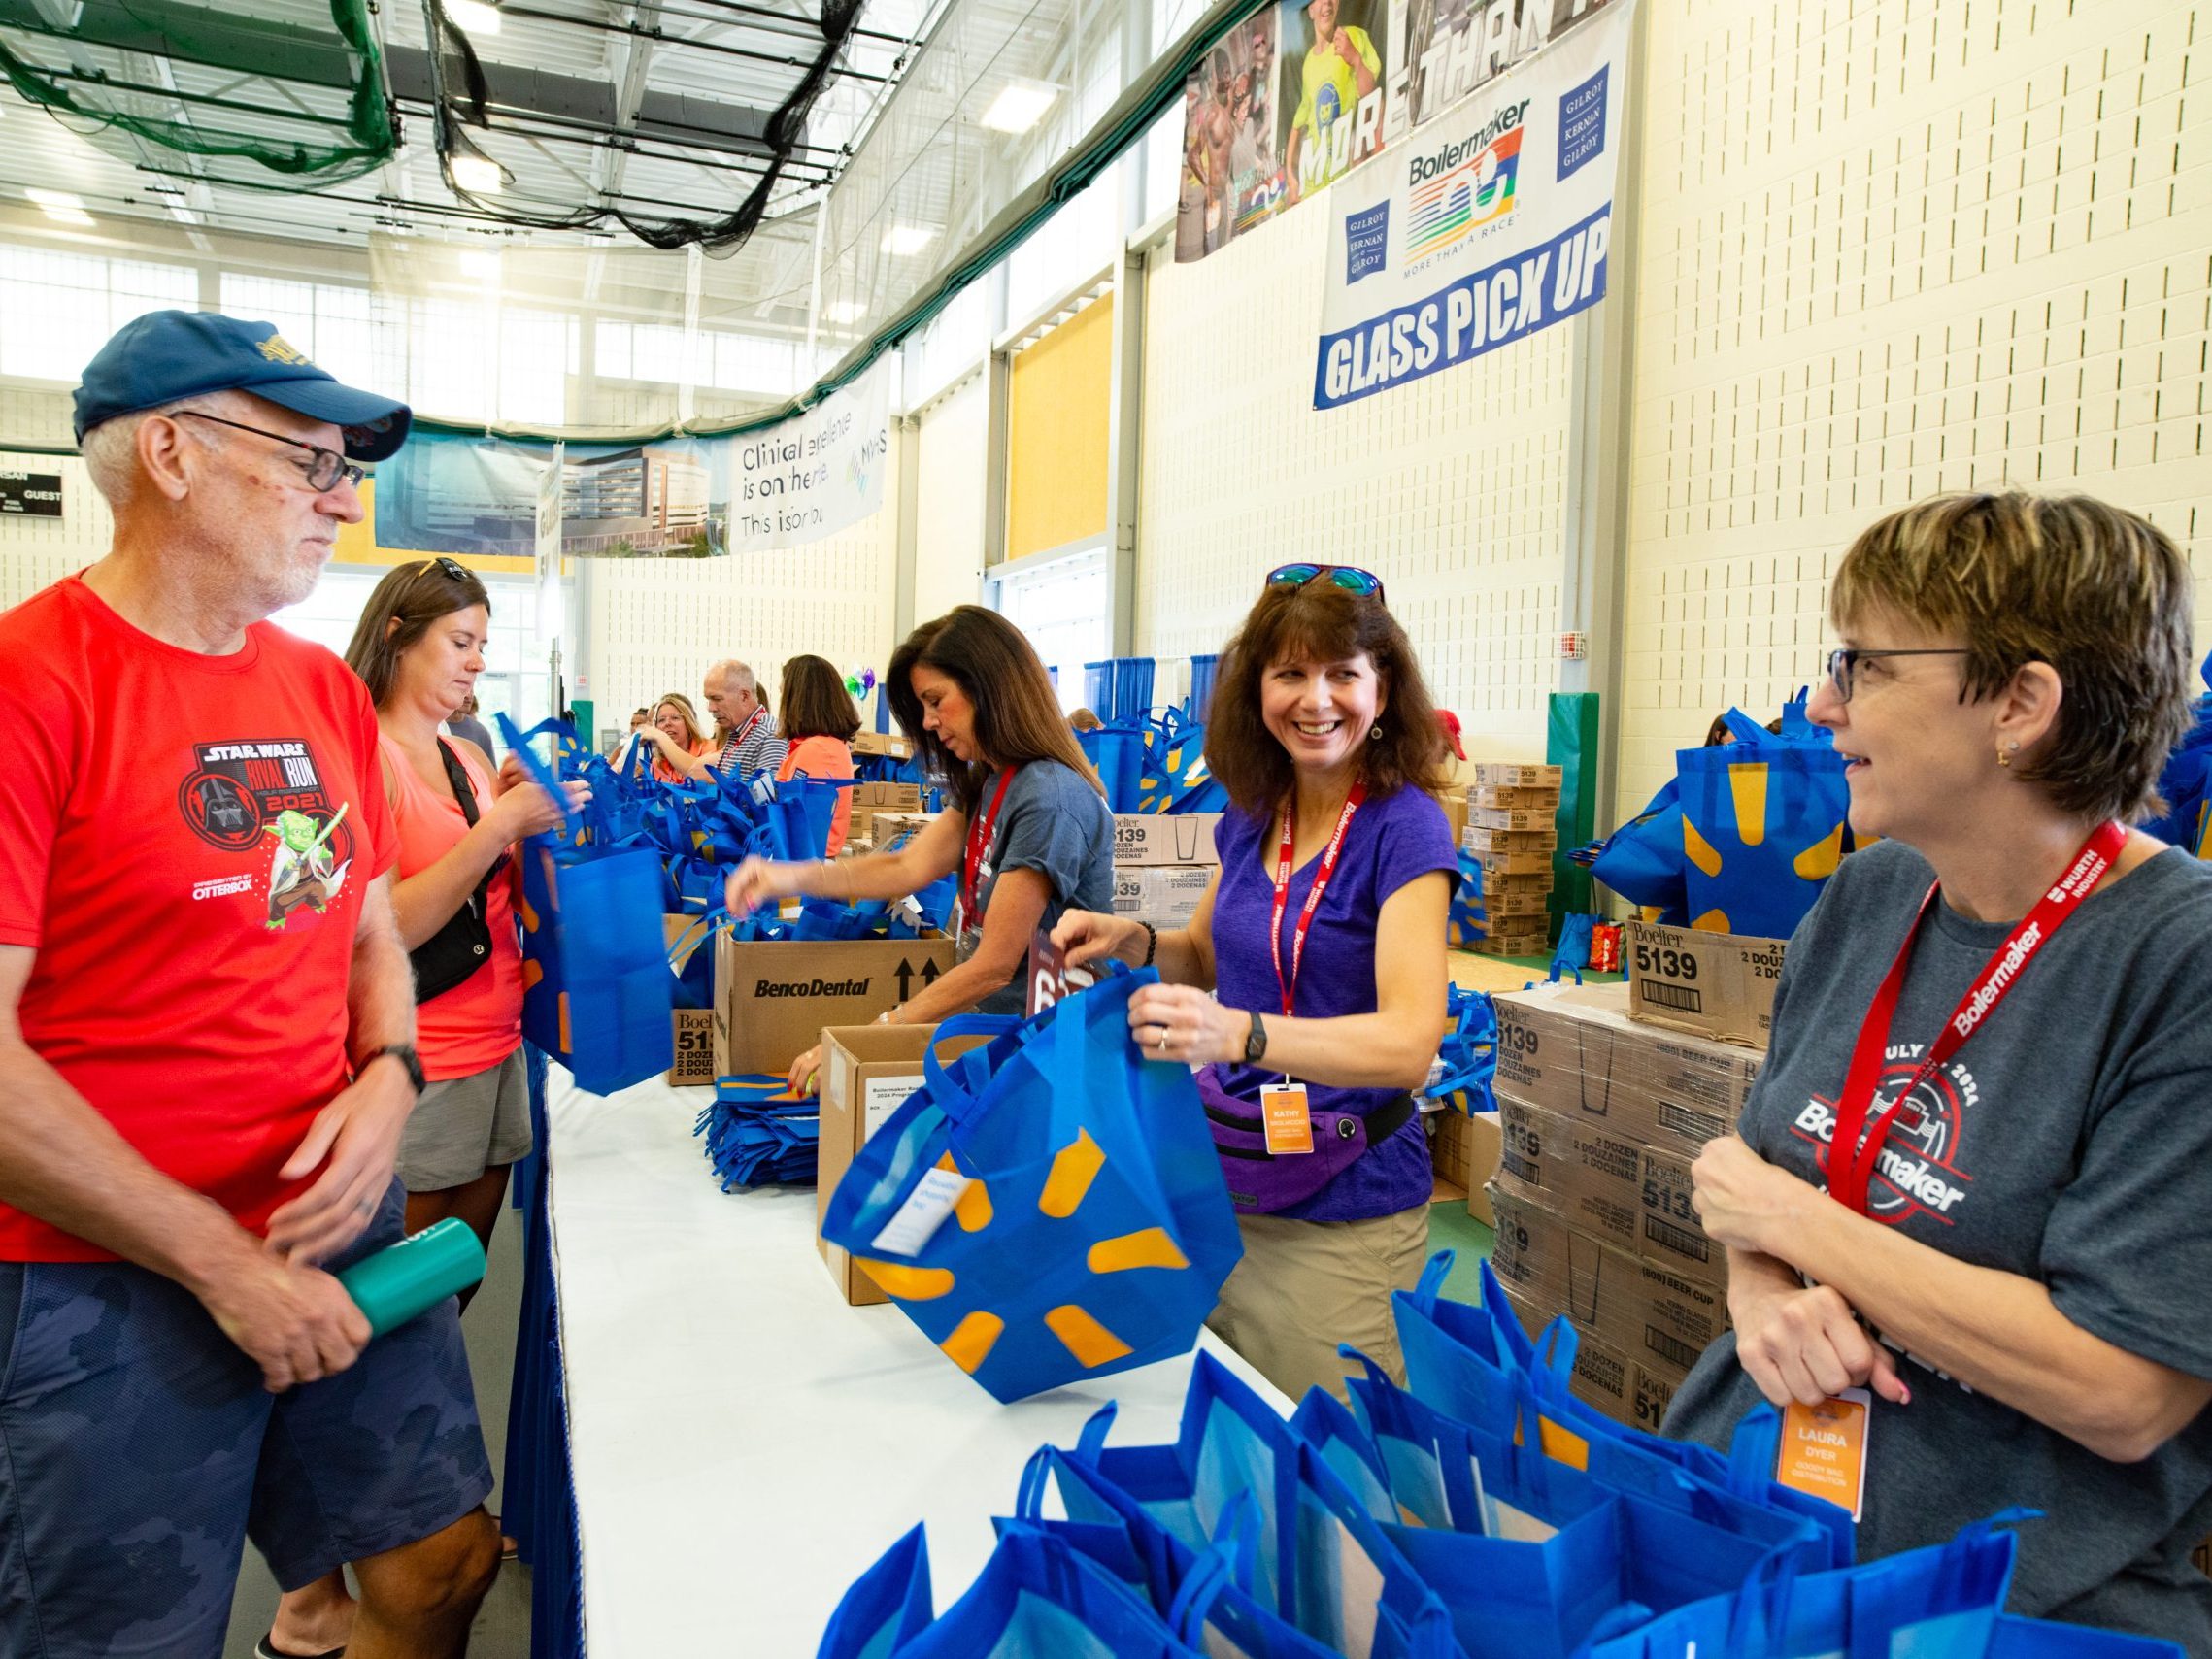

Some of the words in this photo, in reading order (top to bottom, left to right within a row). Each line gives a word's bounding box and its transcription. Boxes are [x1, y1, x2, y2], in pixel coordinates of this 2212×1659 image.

[1299, 65, 1409, 194] MORE
[1419, 0, 1556, 119] THAN
[1565, 79, 1604, 115] GILROY
[1564, 106, 1601, 141] KERNAN
[1409, 99, 1531, 186] Boilermaker
[1563, 133, 1599, 167] GILROY
[1350, 212, 1385, 232] GILROY
[1403, 257, 1432, 280] MORE
[1469, 234, 1475, 244] A
[1481, 216, 1515, 239] RACE
[1324, 302, 1439, 400] GLASS
[1447, 252, 1550, 360] PICK
[1553, 215, 1611, 312] UP
[743, 433, 803, 472] Clinical
[23, 489, 62, 501] GUEST
[743, 477, 754, 501] is
[759, 477, 785, 498] on
[741, 513, 771, 537] This
[204, 744, 259, 762] STAR
[256, 743, 305, 757] WARS
[244, 759, 289, 791] RIVAL
[283, 757, 318, 787] RUN
[265, 792, 324, 812] 2021
[1115, 828, 1146, 843] 139
[1324, 801, 1357, 870] Boilermaker
[2061, 848, 2098, 890] WURTH
[2072, 857, 2107, 898] INDUSTRY
[192, 879, 252, 901] OTTERBOX
[1115, 882, 1141, 896] 39
[1633, 923, 1684, 948] Boelter
[1769, 944, 1777, 954] 2
[1636, 945, 1697, 980] 5139
[1741, 952, 1749, 962] 2
[1752, 953, 1785, 968] DOUZ
[1755, 966, 1762, 977] 2
[1953, 920, 2042, 1037] Boilermaker
[678, 1014, 713, 1029] Boel
[1498, 1046, 1523, 1063] DOZEN
[1497, 1066, 1533, 1087] DOCENAS
[1885, 1044, 1925, 1060] ULY
[1950, 1064, 1980, 1108] 2024
[1506, 1123, 1540, 1157] 139
[1604, 1140, 1639, 1161] DOZEN
[1795, 1099, 1966, 1211] Bomaker
[1582, 1143, 1638, 1172] DOUZAINES
[1590, 1157, 1637, 1182] DOCENAS
[1645, 1155, 1693, 1190] Boelte
[1641, 1179, 1701, 1228] 513
[1666, 1279, 1692, 1296] BEER
[1693, 1289, 1714, 1305] CUP
[1576, 1353, 1624, 1387] OUZAINES
[1579, 1366, 1624, 1399] DOCENAS
[1634, 1390, 1660, 1429] 51
[1798, 1427, 1848, 1448] LAURA
[1805, 1446, 1837, 1462] DYER
